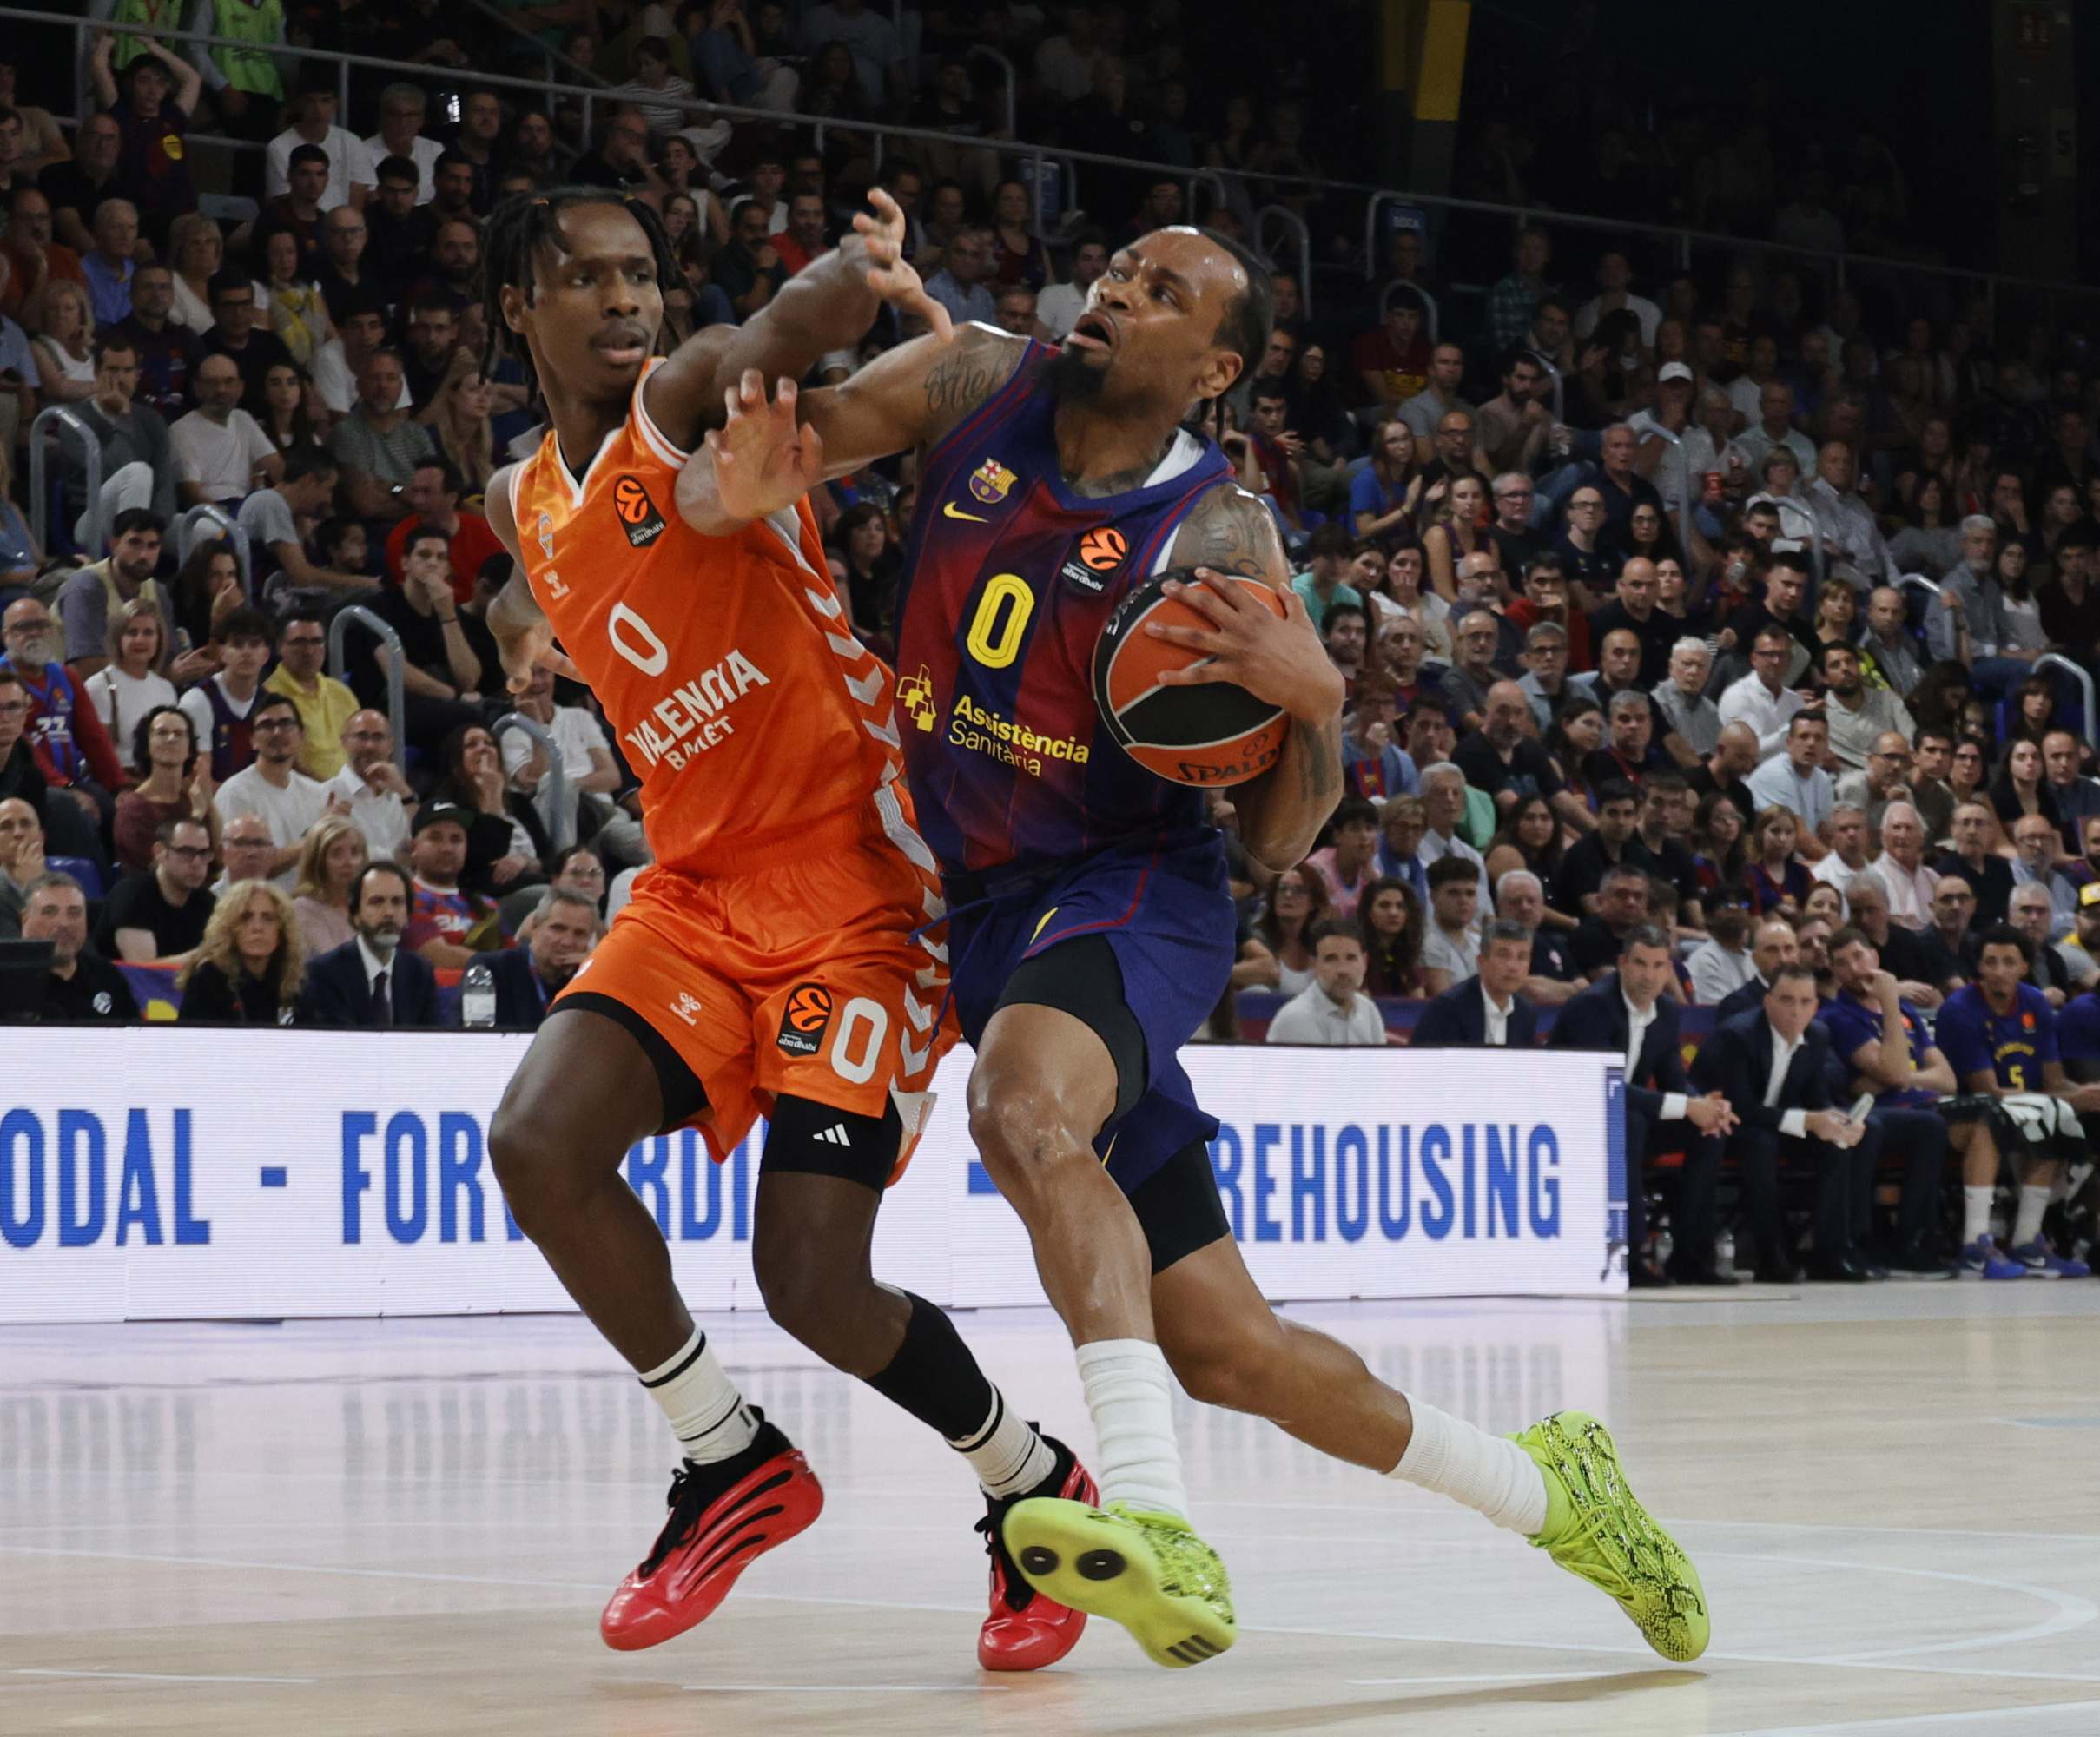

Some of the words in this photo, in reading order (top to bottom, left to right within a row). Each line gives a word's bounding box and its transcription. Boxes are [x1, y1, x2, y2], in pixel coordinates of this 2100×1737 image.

[609, 601, 668, 677] 0
[967, 572, 1035, 669] 0
[948, 720, 1042, 777] Sanitària
[953, 694, 1090, 764] Assistència
[830, 996, 888, 1085] 0
[0, 1107, 210, 1248] ODAL
